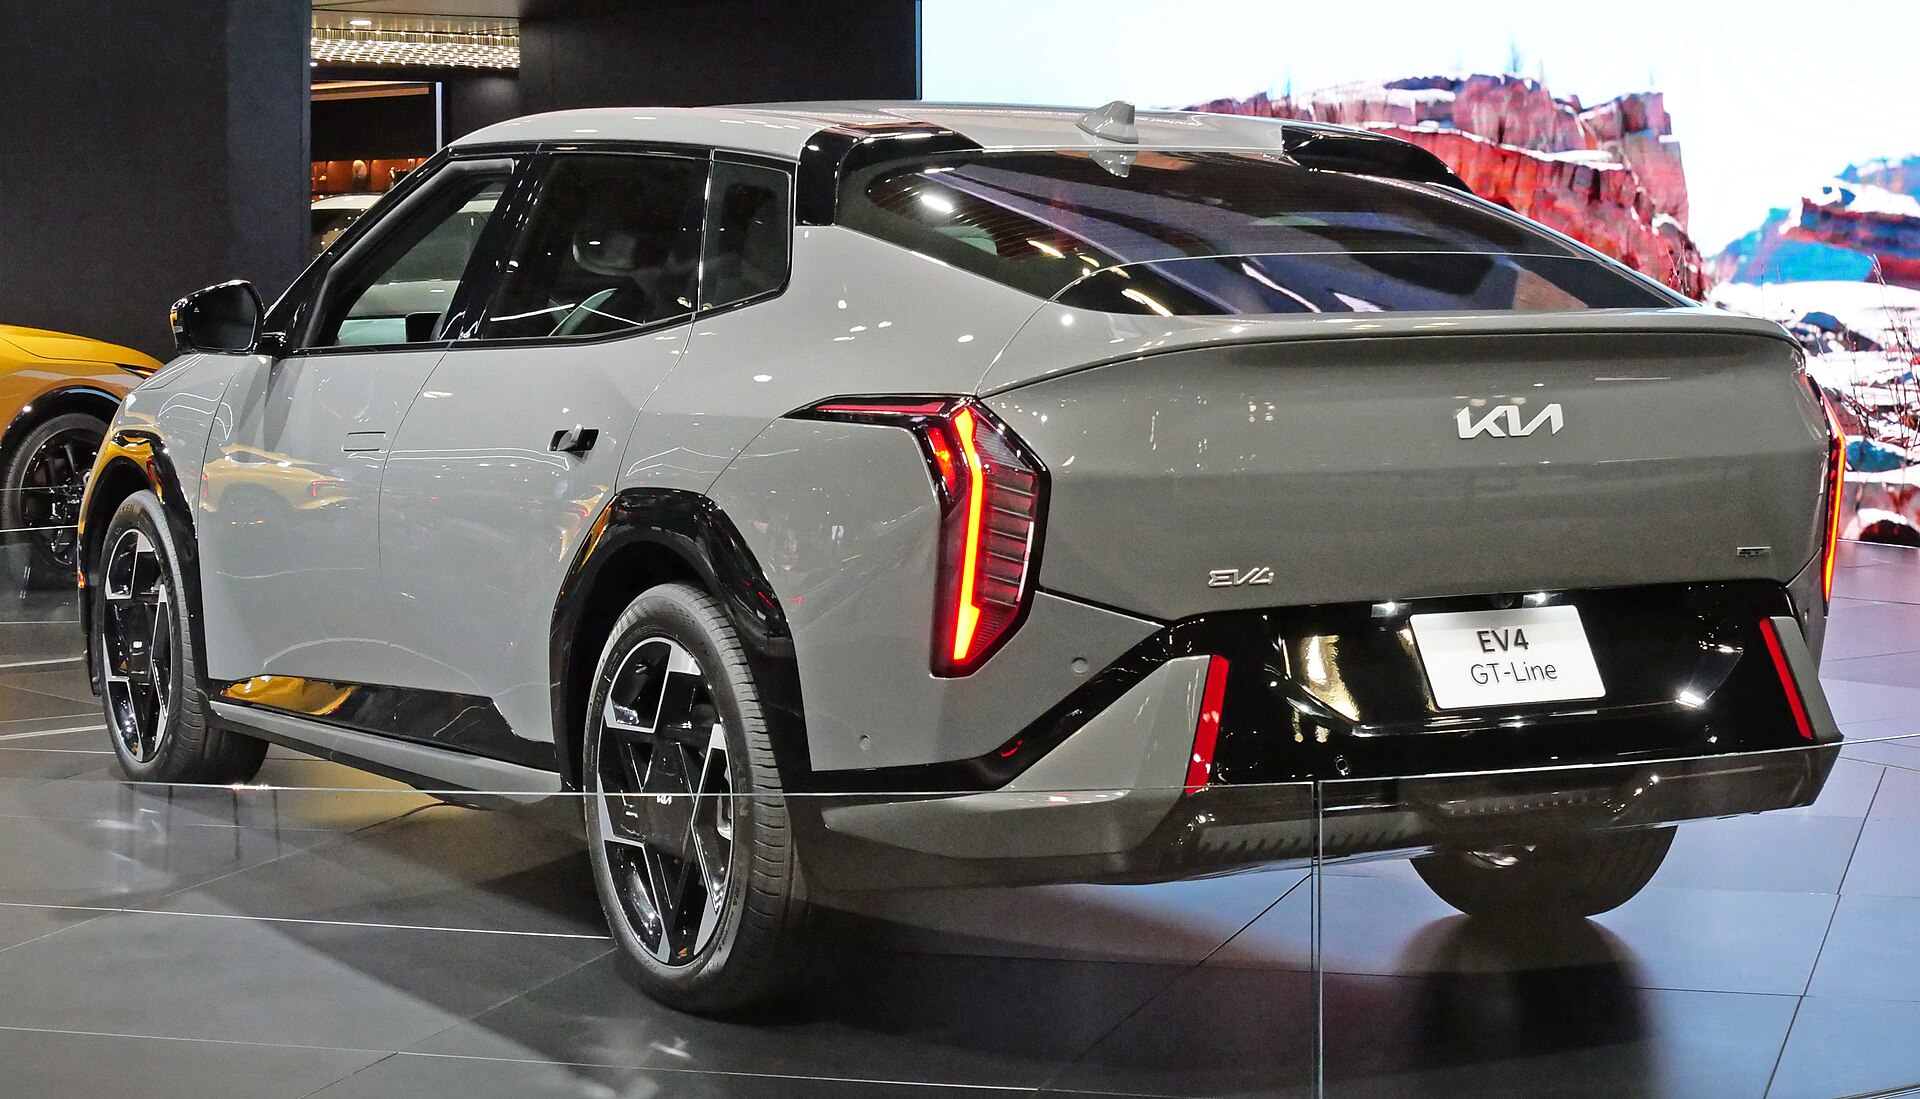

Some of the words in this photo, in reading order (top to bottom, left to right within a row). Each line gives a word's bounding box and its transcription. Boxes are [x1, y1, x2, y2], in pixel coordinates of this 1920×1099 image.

[1456, 403, 1564, 439] KIA
[1208, 567, 1275, 587] EV4
[1476, 628, 1529, 653] EV4
[1470, 661, 1558, 685] GT-Line
